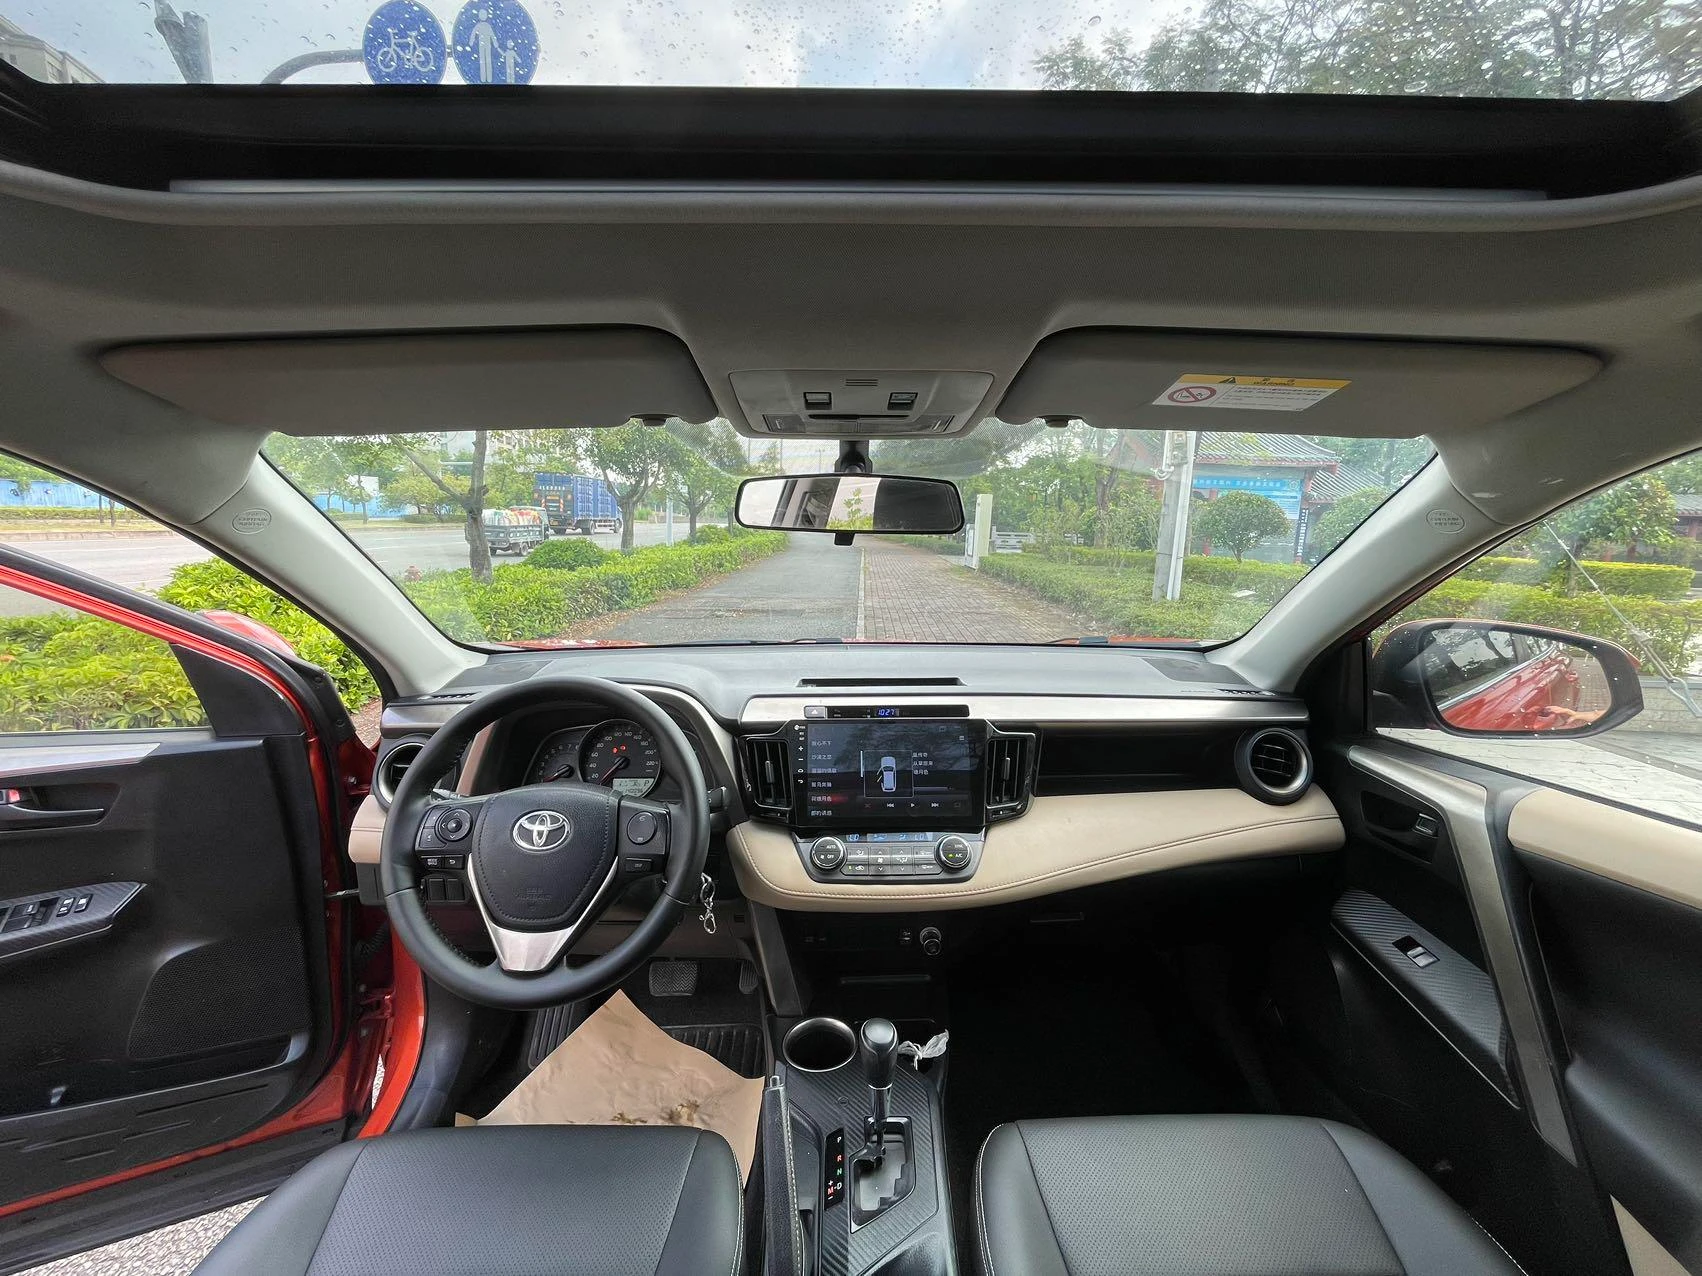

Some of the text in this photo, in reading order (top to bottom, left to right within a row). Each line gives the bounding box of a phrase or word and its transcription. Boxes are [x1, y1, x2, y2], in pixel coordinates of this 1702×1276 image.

[836, 1154, 842, 1162] R
[836, 1168, 842, 1176] N
[827, 1187, 834, 1195] M
